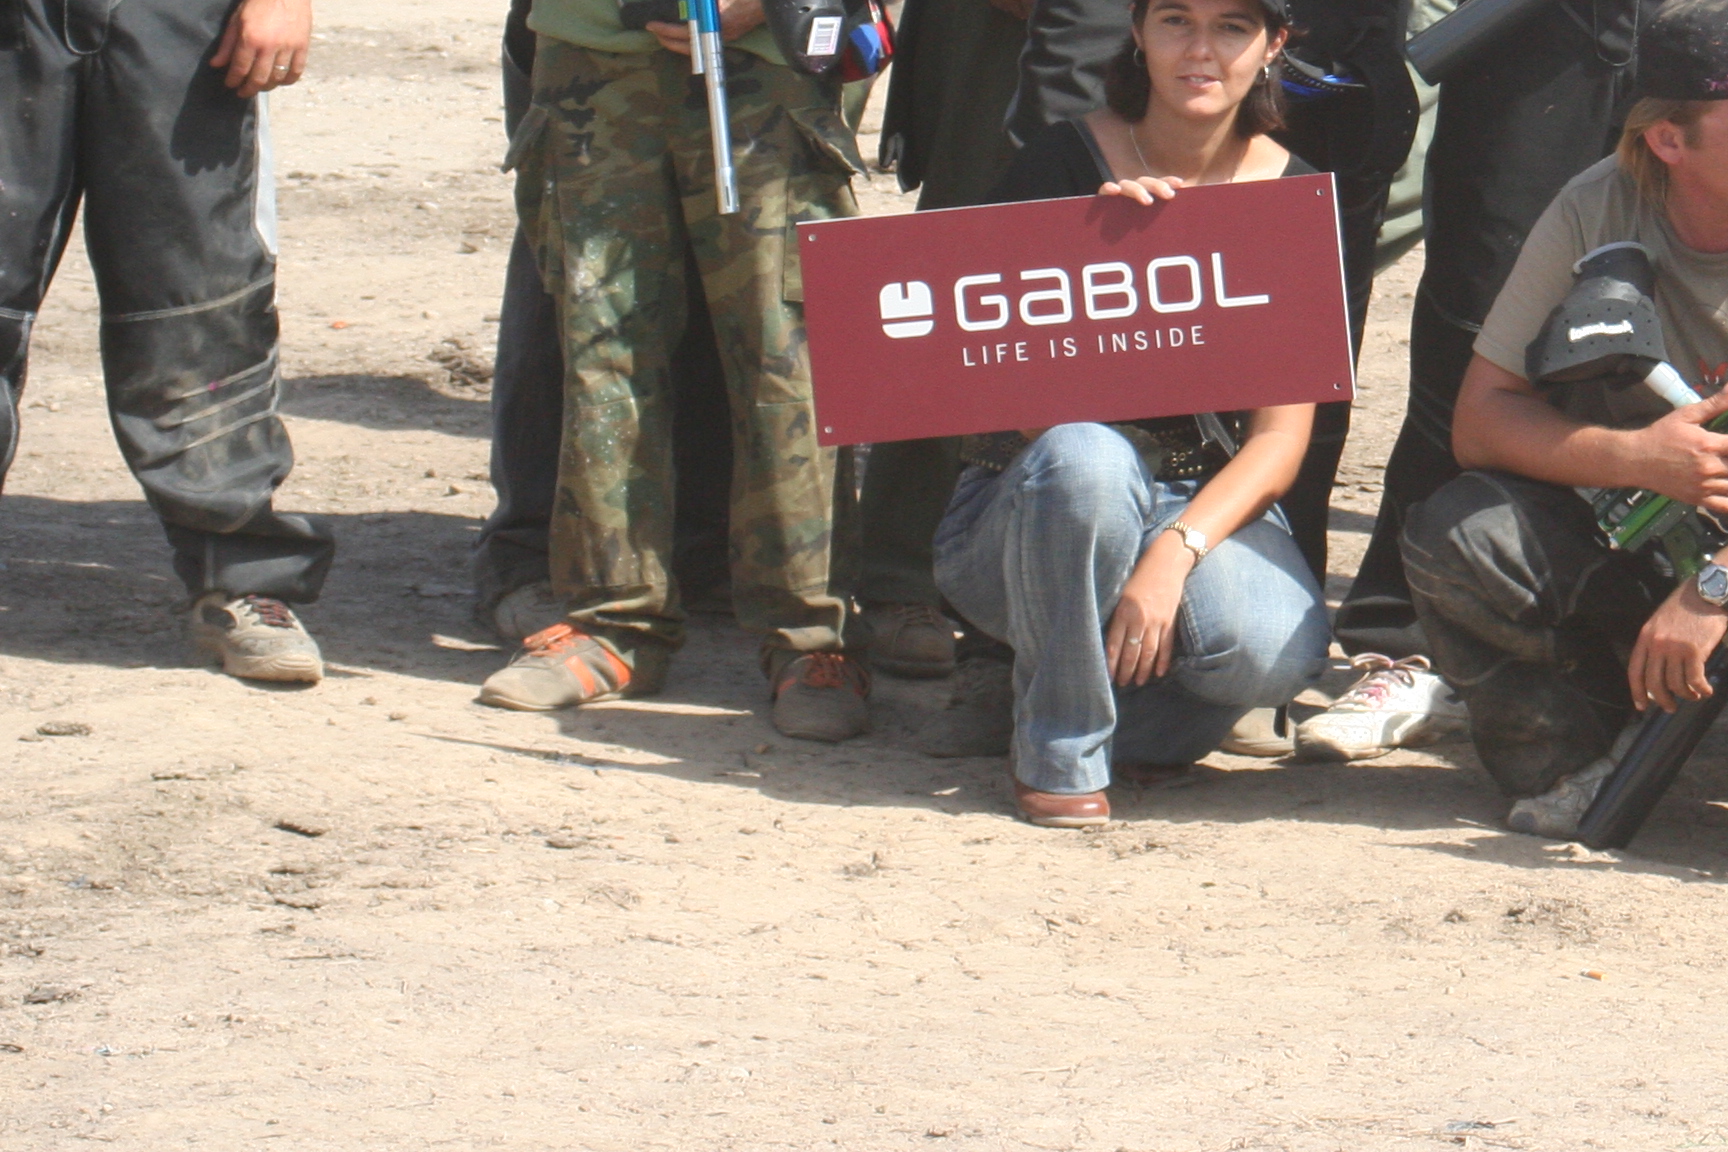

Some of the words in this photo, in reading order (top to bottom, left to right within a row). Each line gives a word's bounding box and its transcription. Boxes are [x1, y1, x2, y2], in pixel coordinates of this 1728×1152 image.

[961, 340, 1030, 368] LIFE
[1048, 337, 1078, 360] IS
[1097, 324, 1206, 355] INSIDE
